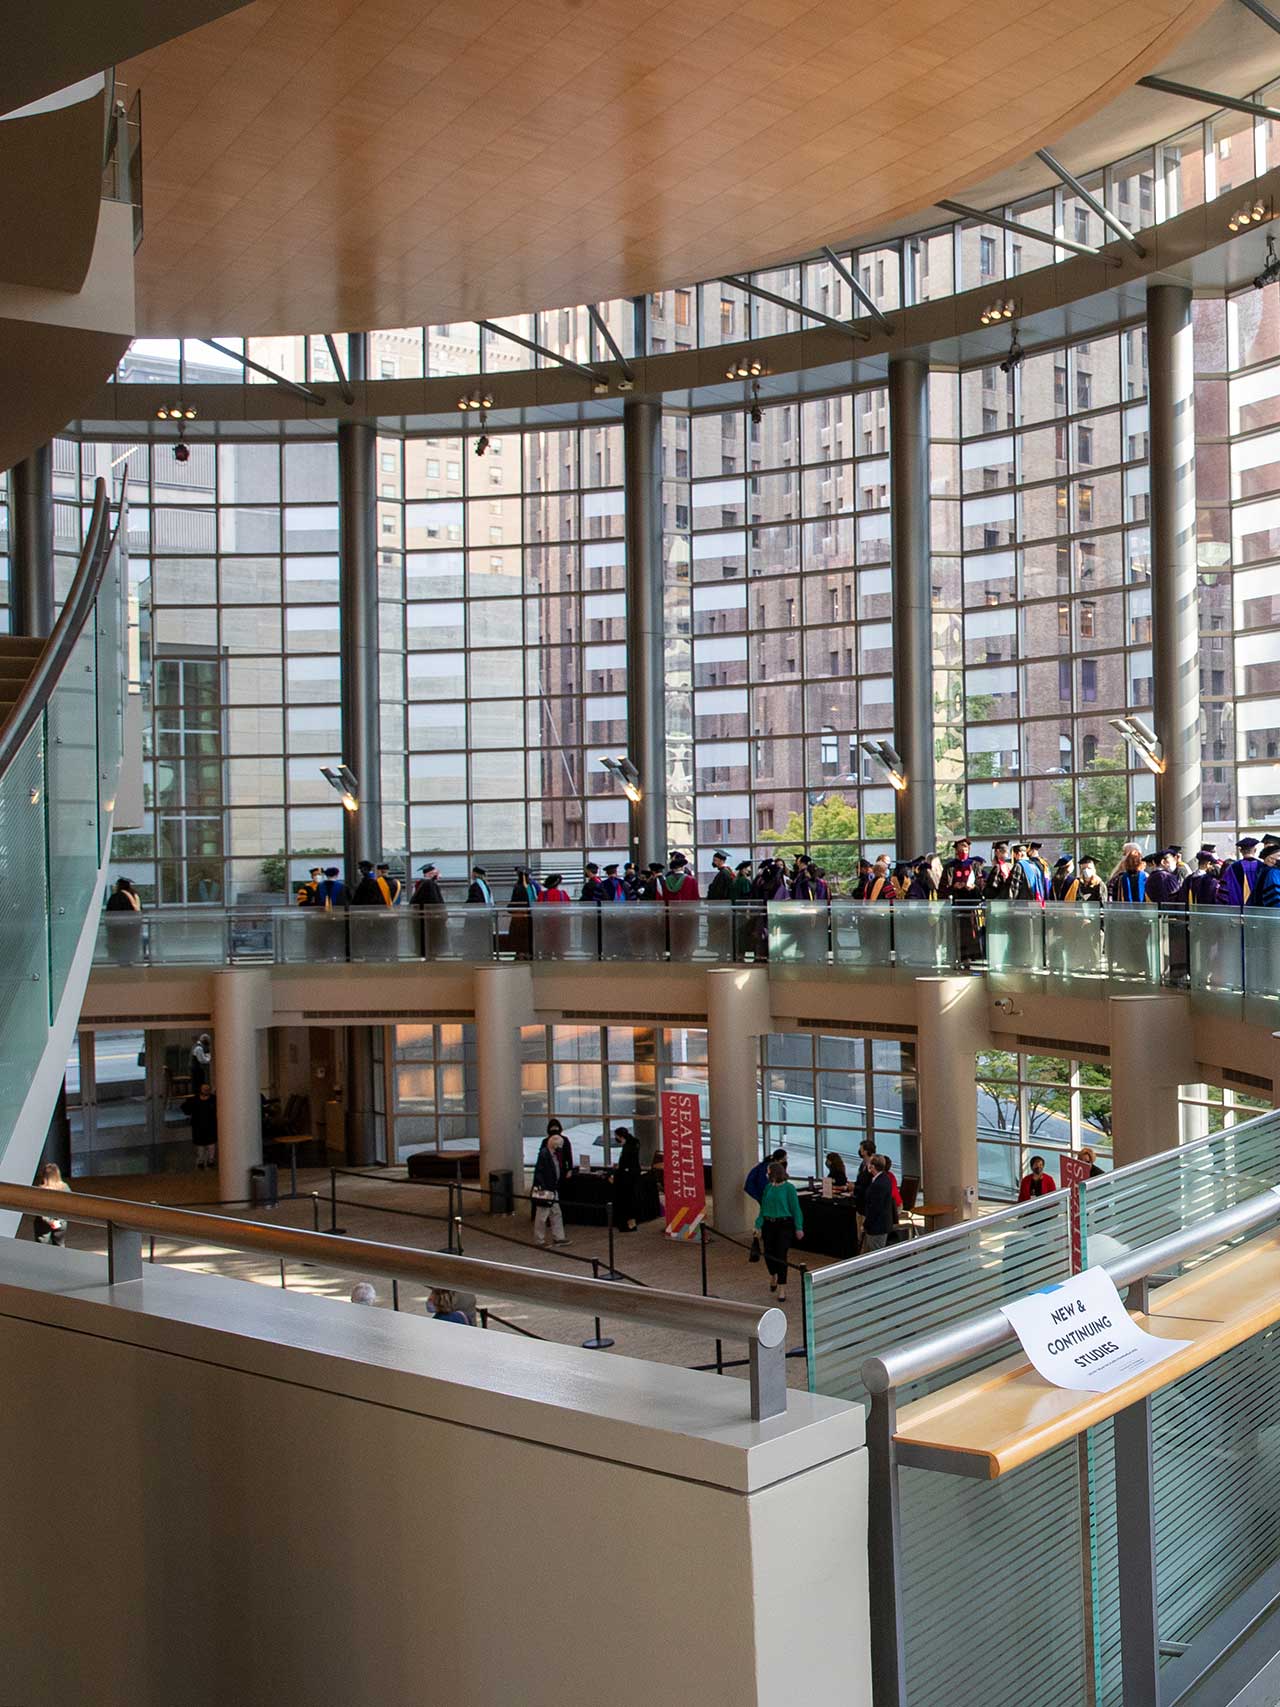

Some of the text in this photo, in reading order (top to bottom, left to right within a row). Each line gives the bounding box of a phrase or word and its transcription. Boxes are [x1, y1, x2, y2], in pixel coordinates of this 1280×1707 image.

[669, 1096, 681, 1197] UNIVERSITY
[679, 1095, 696, 1198] SEATTLE
[1050, 1299, 1087, 1325] NEW &
[1047, 1315, 1113, 1356] CONTINUING
[1073, 1341, 1120, 1368] STUDIES
